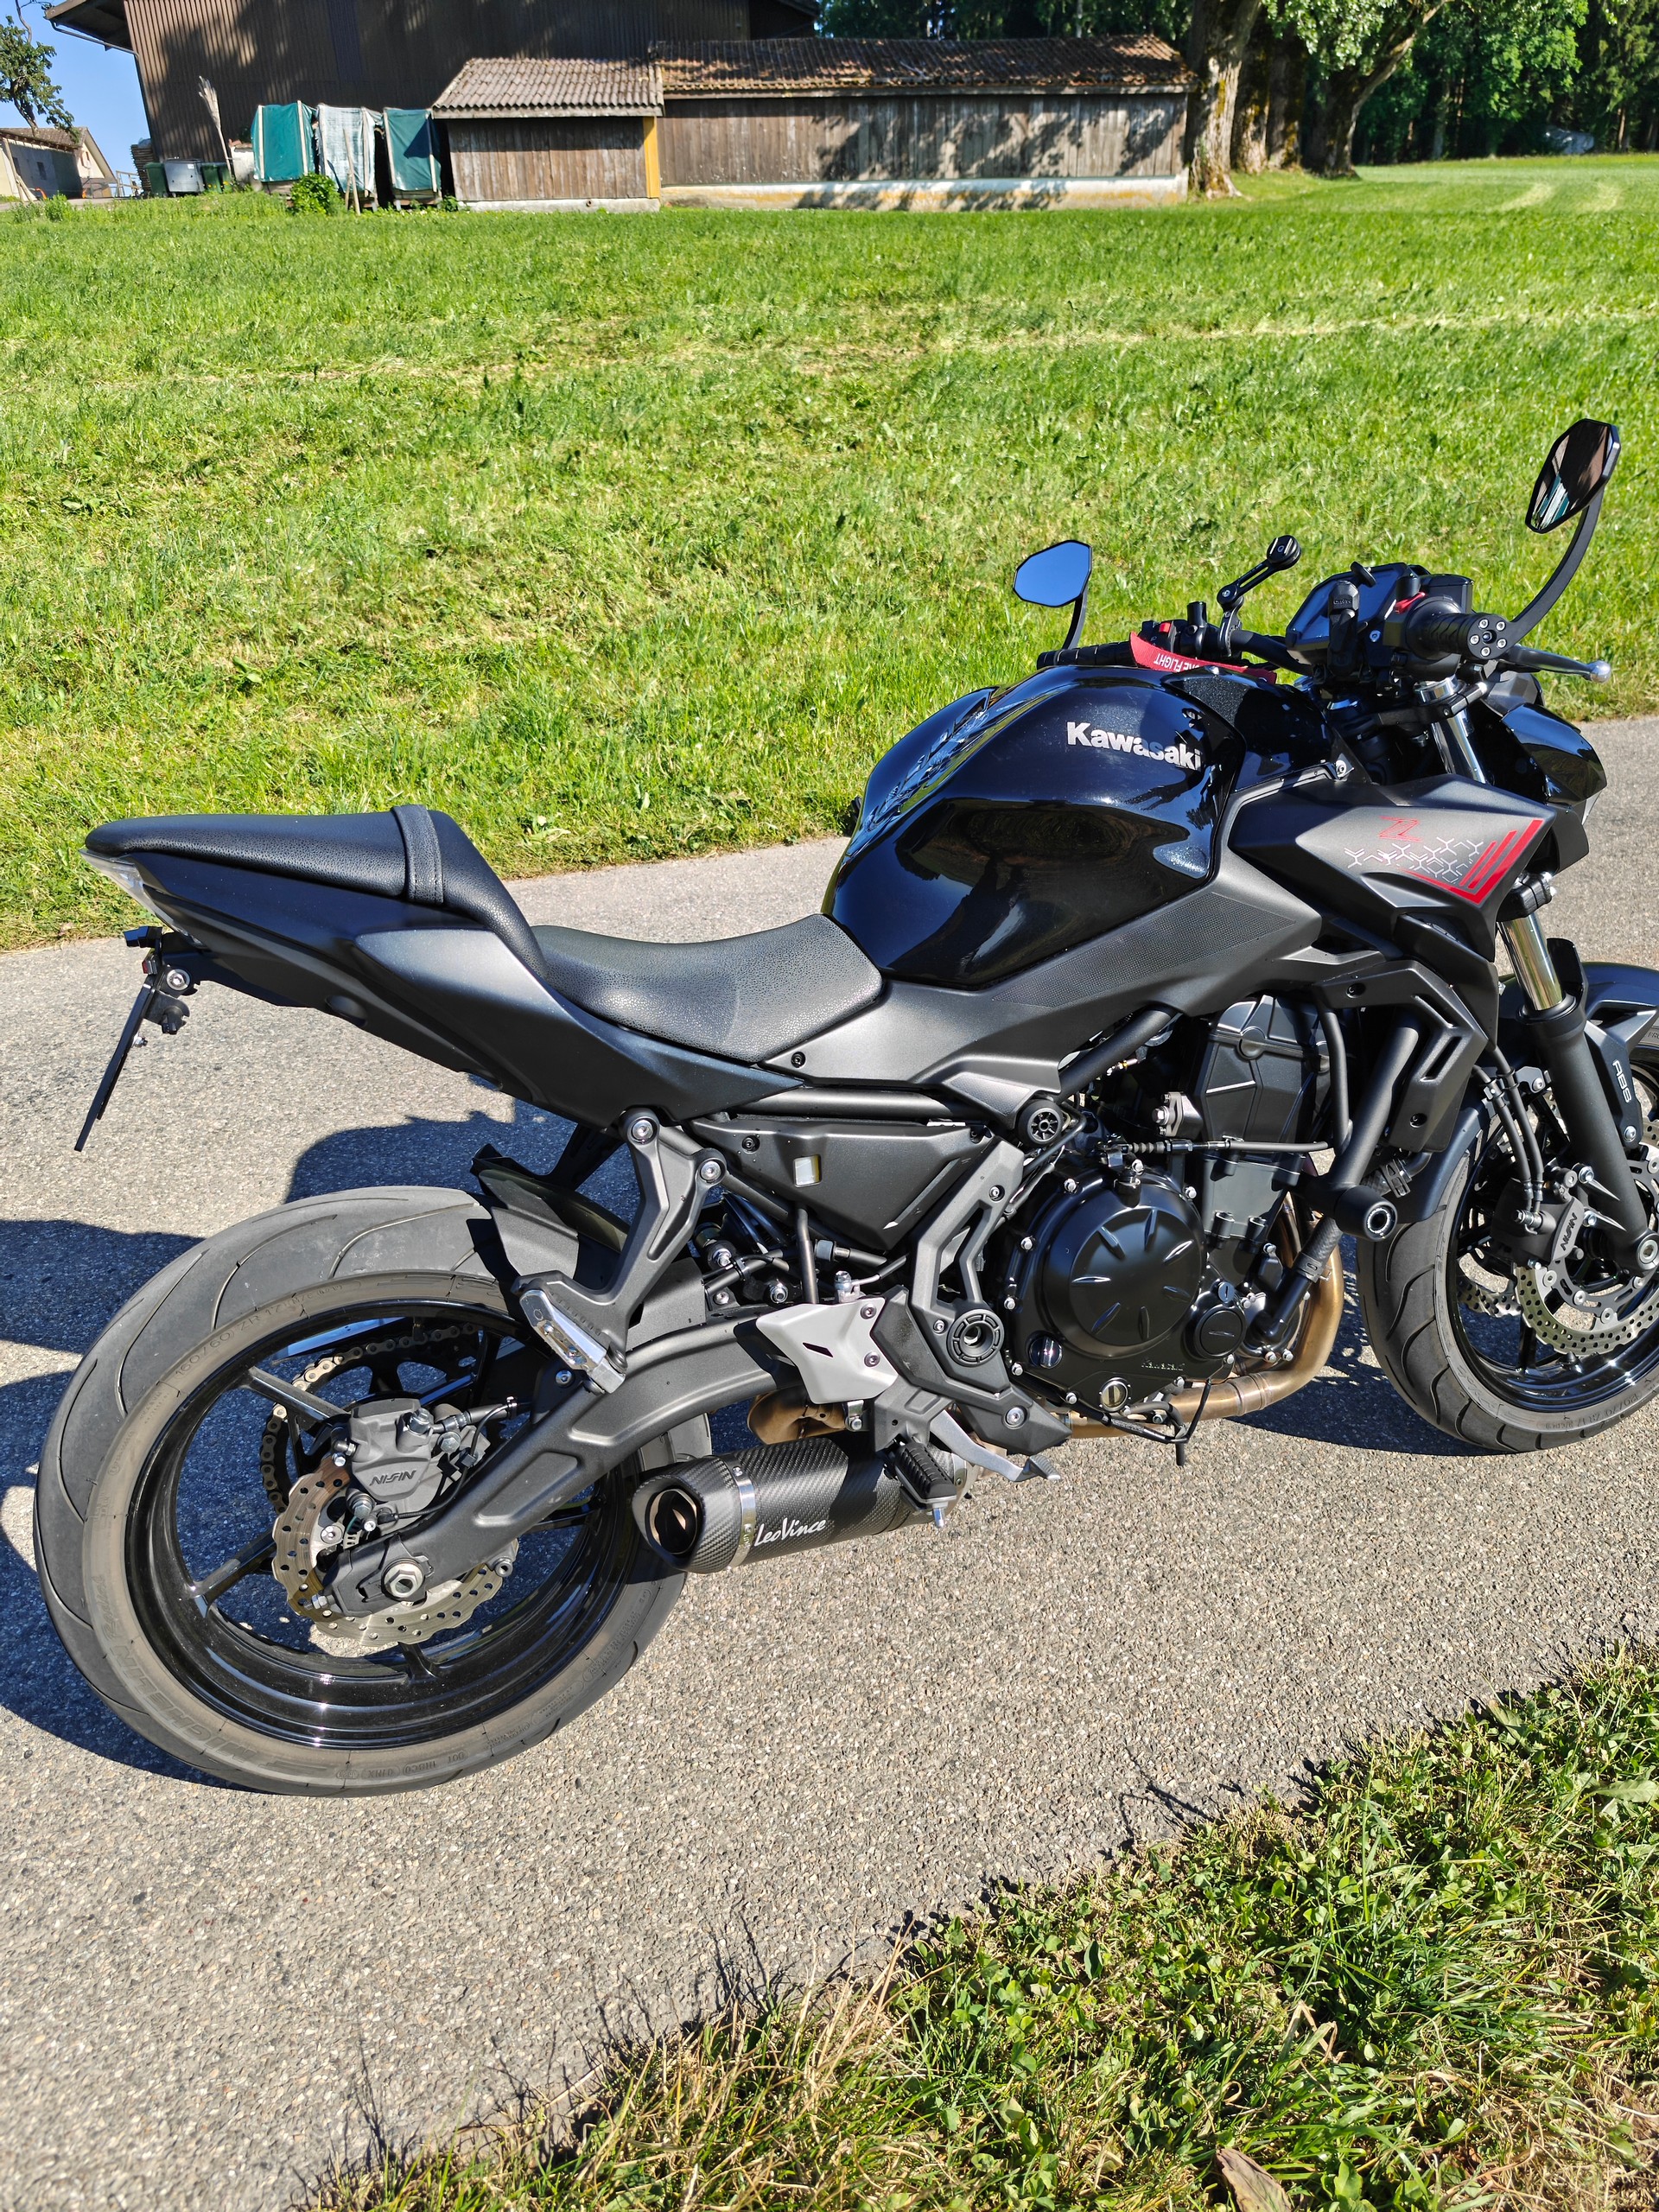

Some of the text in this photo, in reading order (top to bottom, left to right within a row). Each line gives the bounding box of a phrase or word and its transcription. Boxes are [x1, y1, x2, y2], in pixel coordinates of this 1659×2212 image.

[1153, 652, 1185, 673] FLIGHT
[1066, 721, 1202, 772] Kawasaki
[1612, 1059, 1632, 1103] ABS
[1560, 1211, 1578, 1251] NISSIN
[369, 1470, 417, 1486] NISSIN
[753, 1517, 827, 1547] LeoVince
[110, 1644, 258, 1764] MICHELIN
